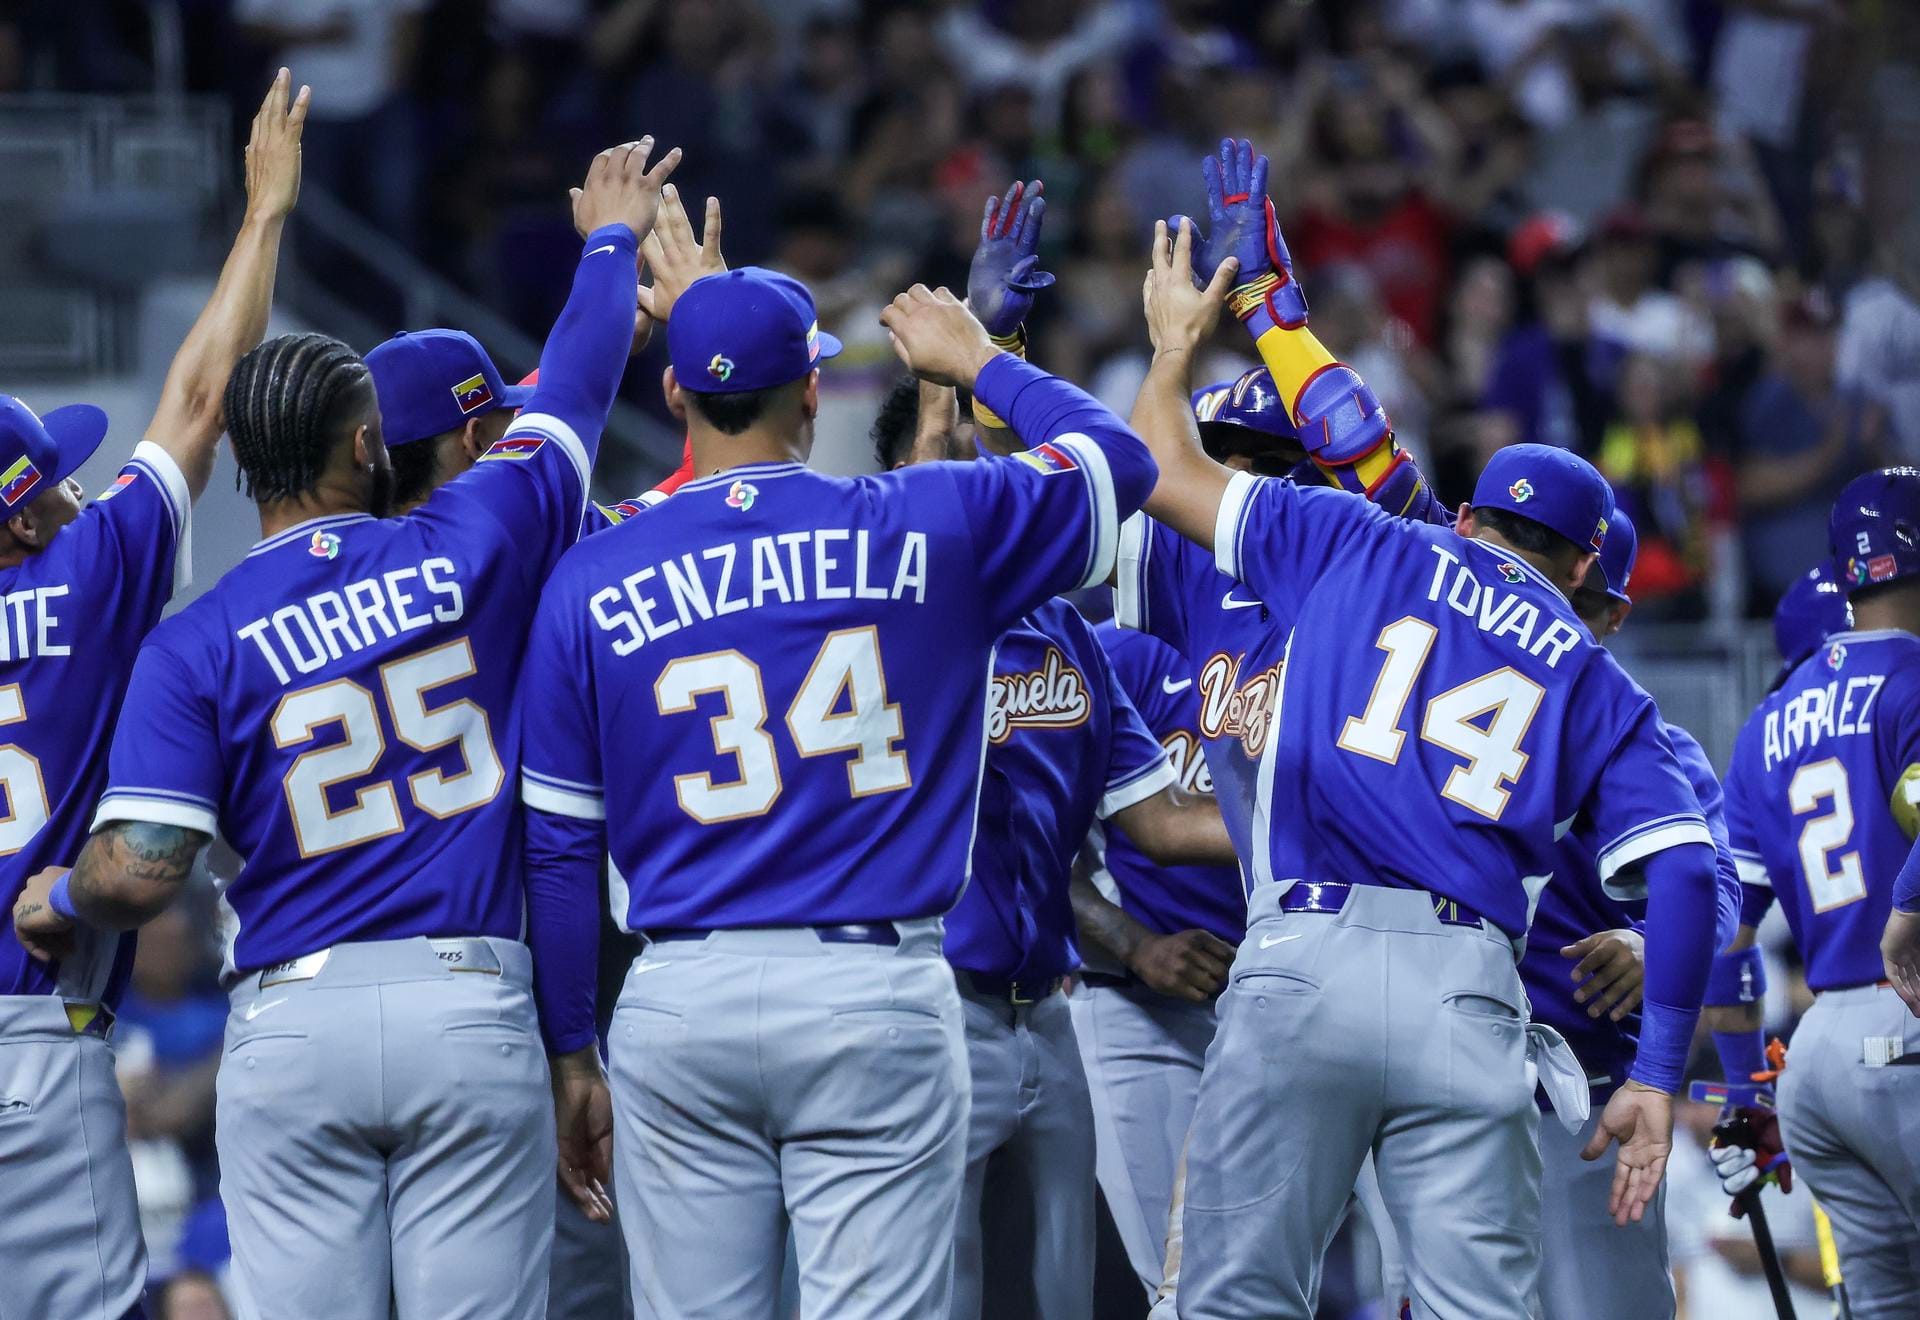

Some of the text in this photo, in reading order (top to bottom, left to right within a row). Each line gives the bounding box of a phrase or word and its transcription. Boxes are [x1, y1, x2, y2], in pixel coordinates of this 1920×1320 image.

[589, 529, 927, 656] SENZATELA
[1427, 543, 1580, 668] TOVAR
[1856, 531, 1871, 555] 2
[237, 557, 464, 685] TORRES
[271, 635, 505, 858] 25
[654, 625, 912, 824] 34
[1336, 615, 1546, 821] 14
[1764, 675, 1885, 772] ARRAEZ
[1788, 757, 1867, 914] 2
